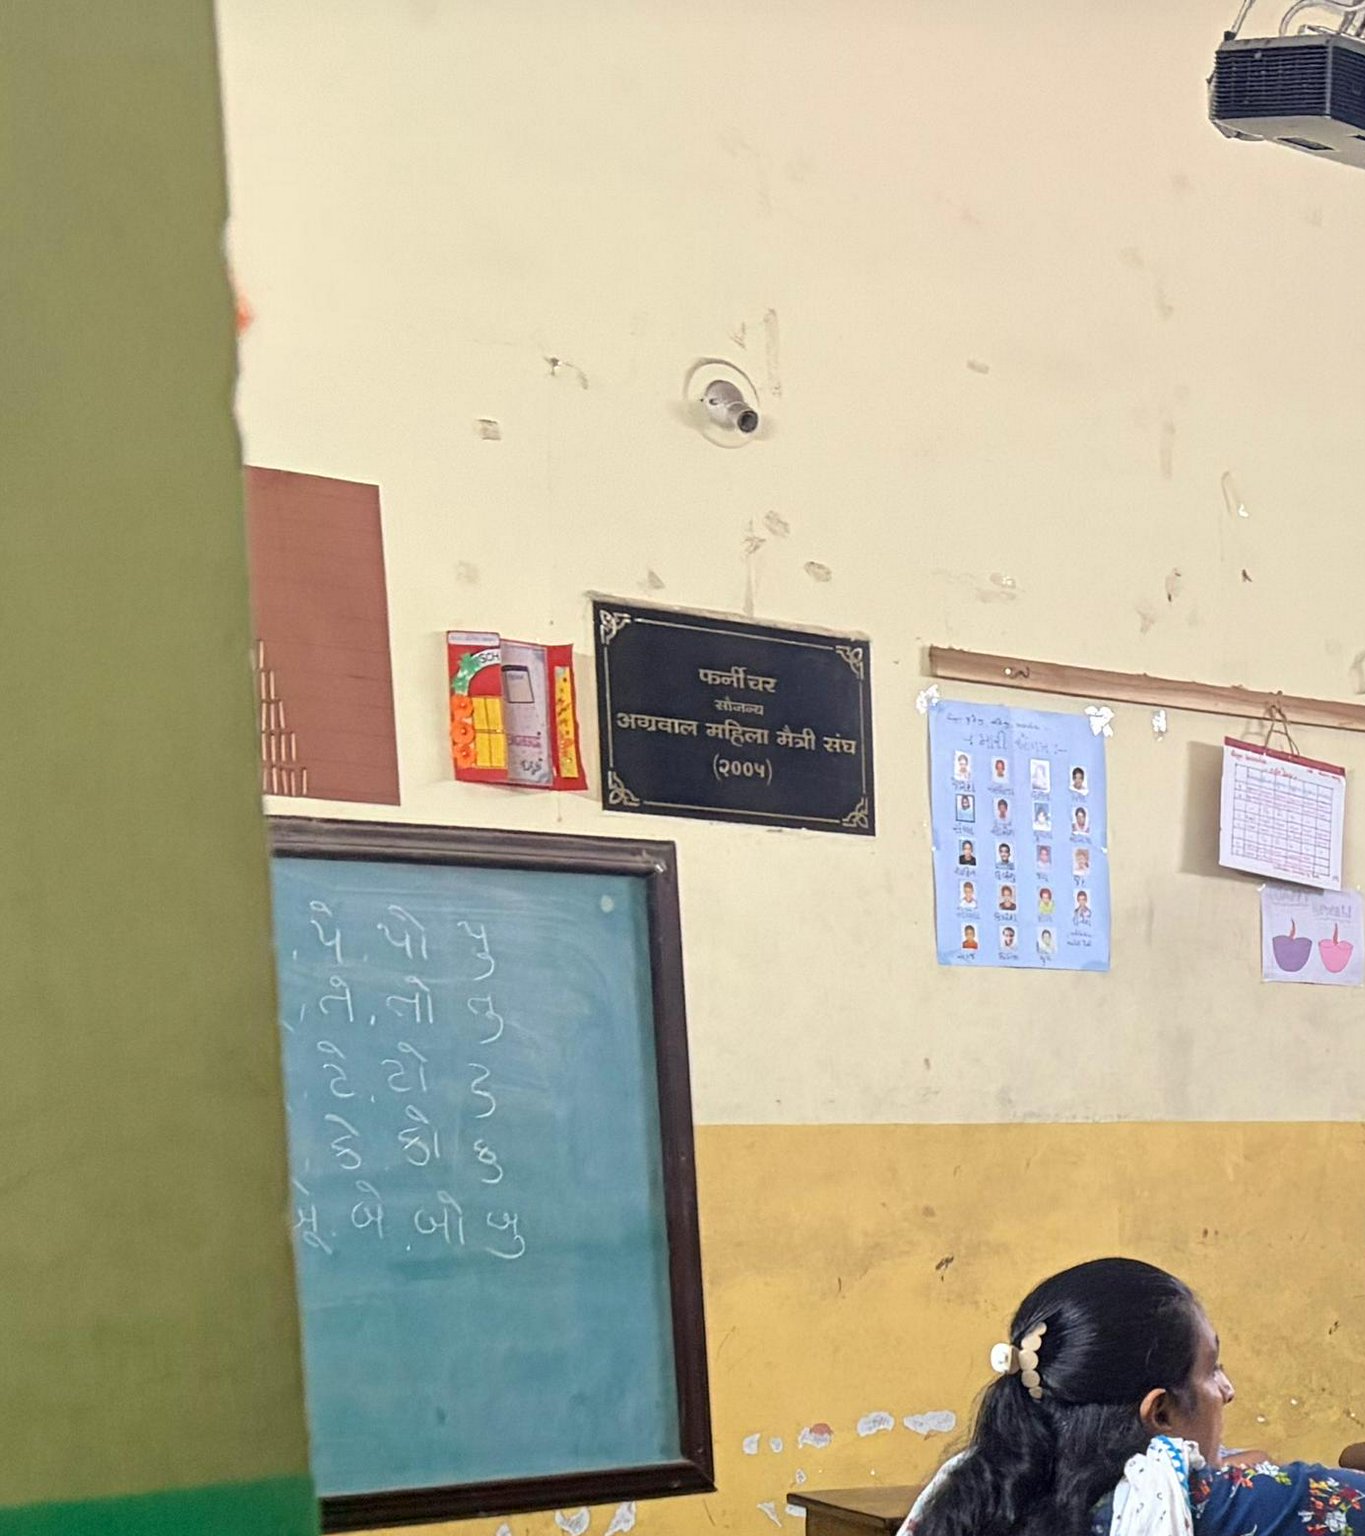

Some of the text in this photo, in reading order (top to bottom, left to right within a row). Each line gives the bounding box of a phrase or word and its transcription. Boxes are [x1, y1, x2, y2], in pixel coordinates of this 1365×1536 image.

[698, 666, 777, 693] फर्नीचर
[713, 696, 765, 716] सौजन्य
[616, 711, 857, 755] अग्रवाल महिला मैत्री संघ
[712, 752, 774, 786] (२००५)
